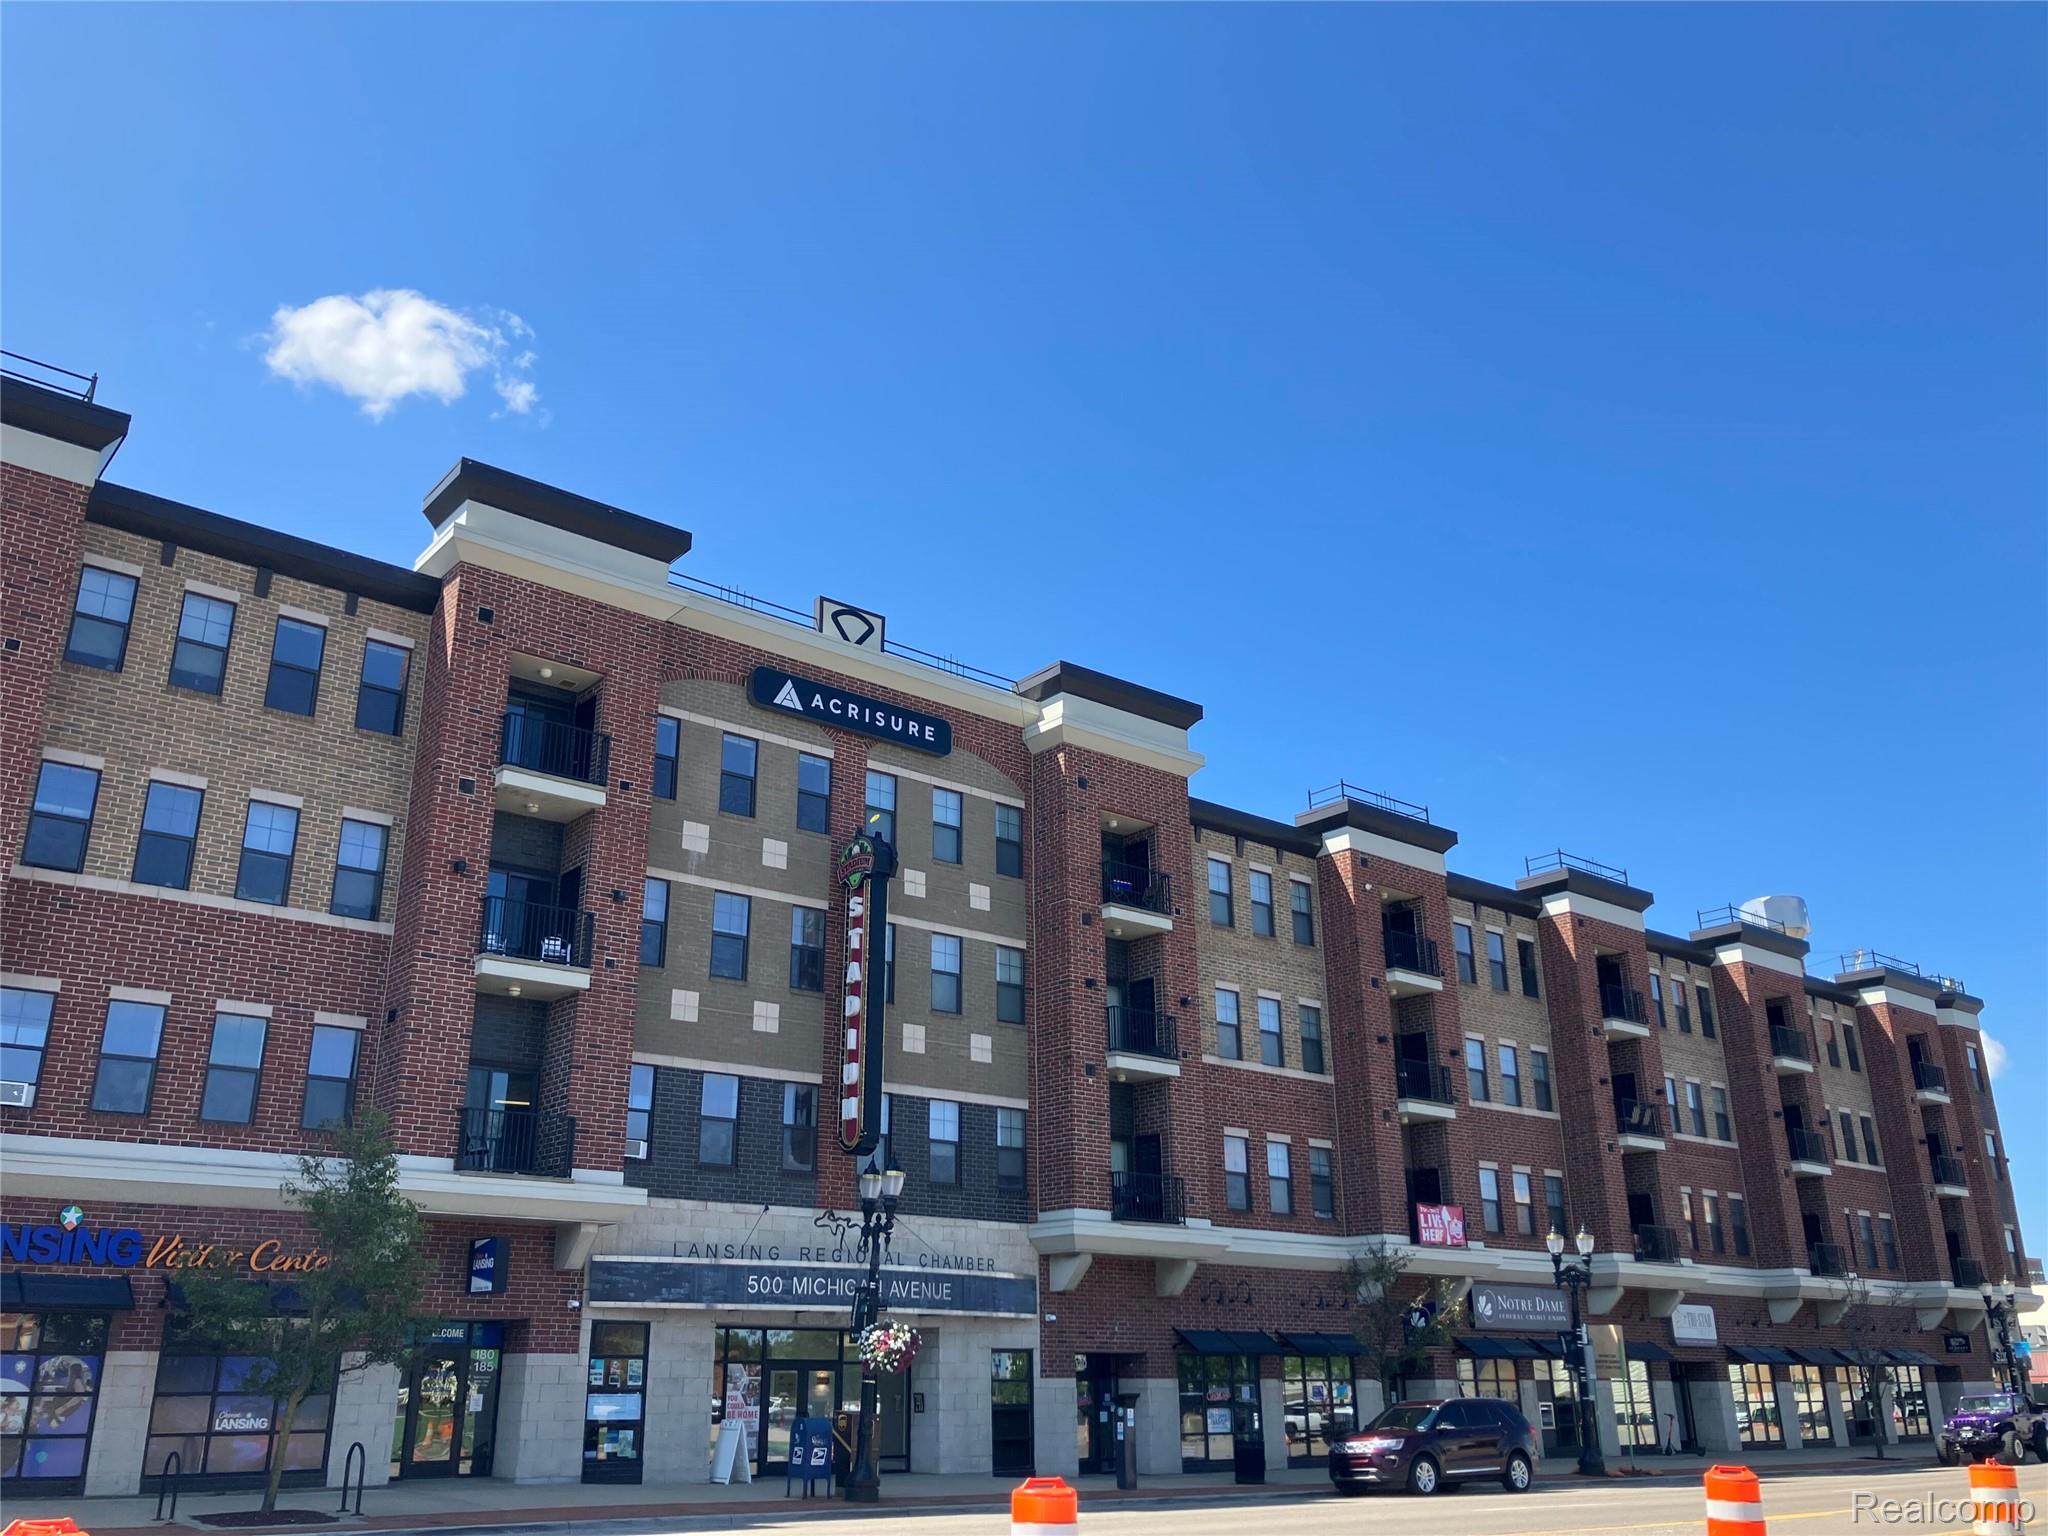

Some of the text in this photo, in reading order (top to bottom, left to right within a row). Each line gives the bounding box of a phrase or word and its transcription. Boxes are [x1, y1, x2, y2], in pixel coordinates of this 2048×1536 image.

[811, 693, 935, 742] ACRISURE
[250, 1239, 331, 1272] Cente
[673, 1243, 995, 1271] LANSING REGIOAL CHAMBER
[747, 1275, 783, 1294] 500
[889, 1280, 952, 1300] AVENUE
[1497, 1295, 1566, 1313] NOTRE DAME
[475, 1349, 495, 1360] 180
[473, 1361, 494, 1372] 185
[737, 1410, 759, 1419] HOME
